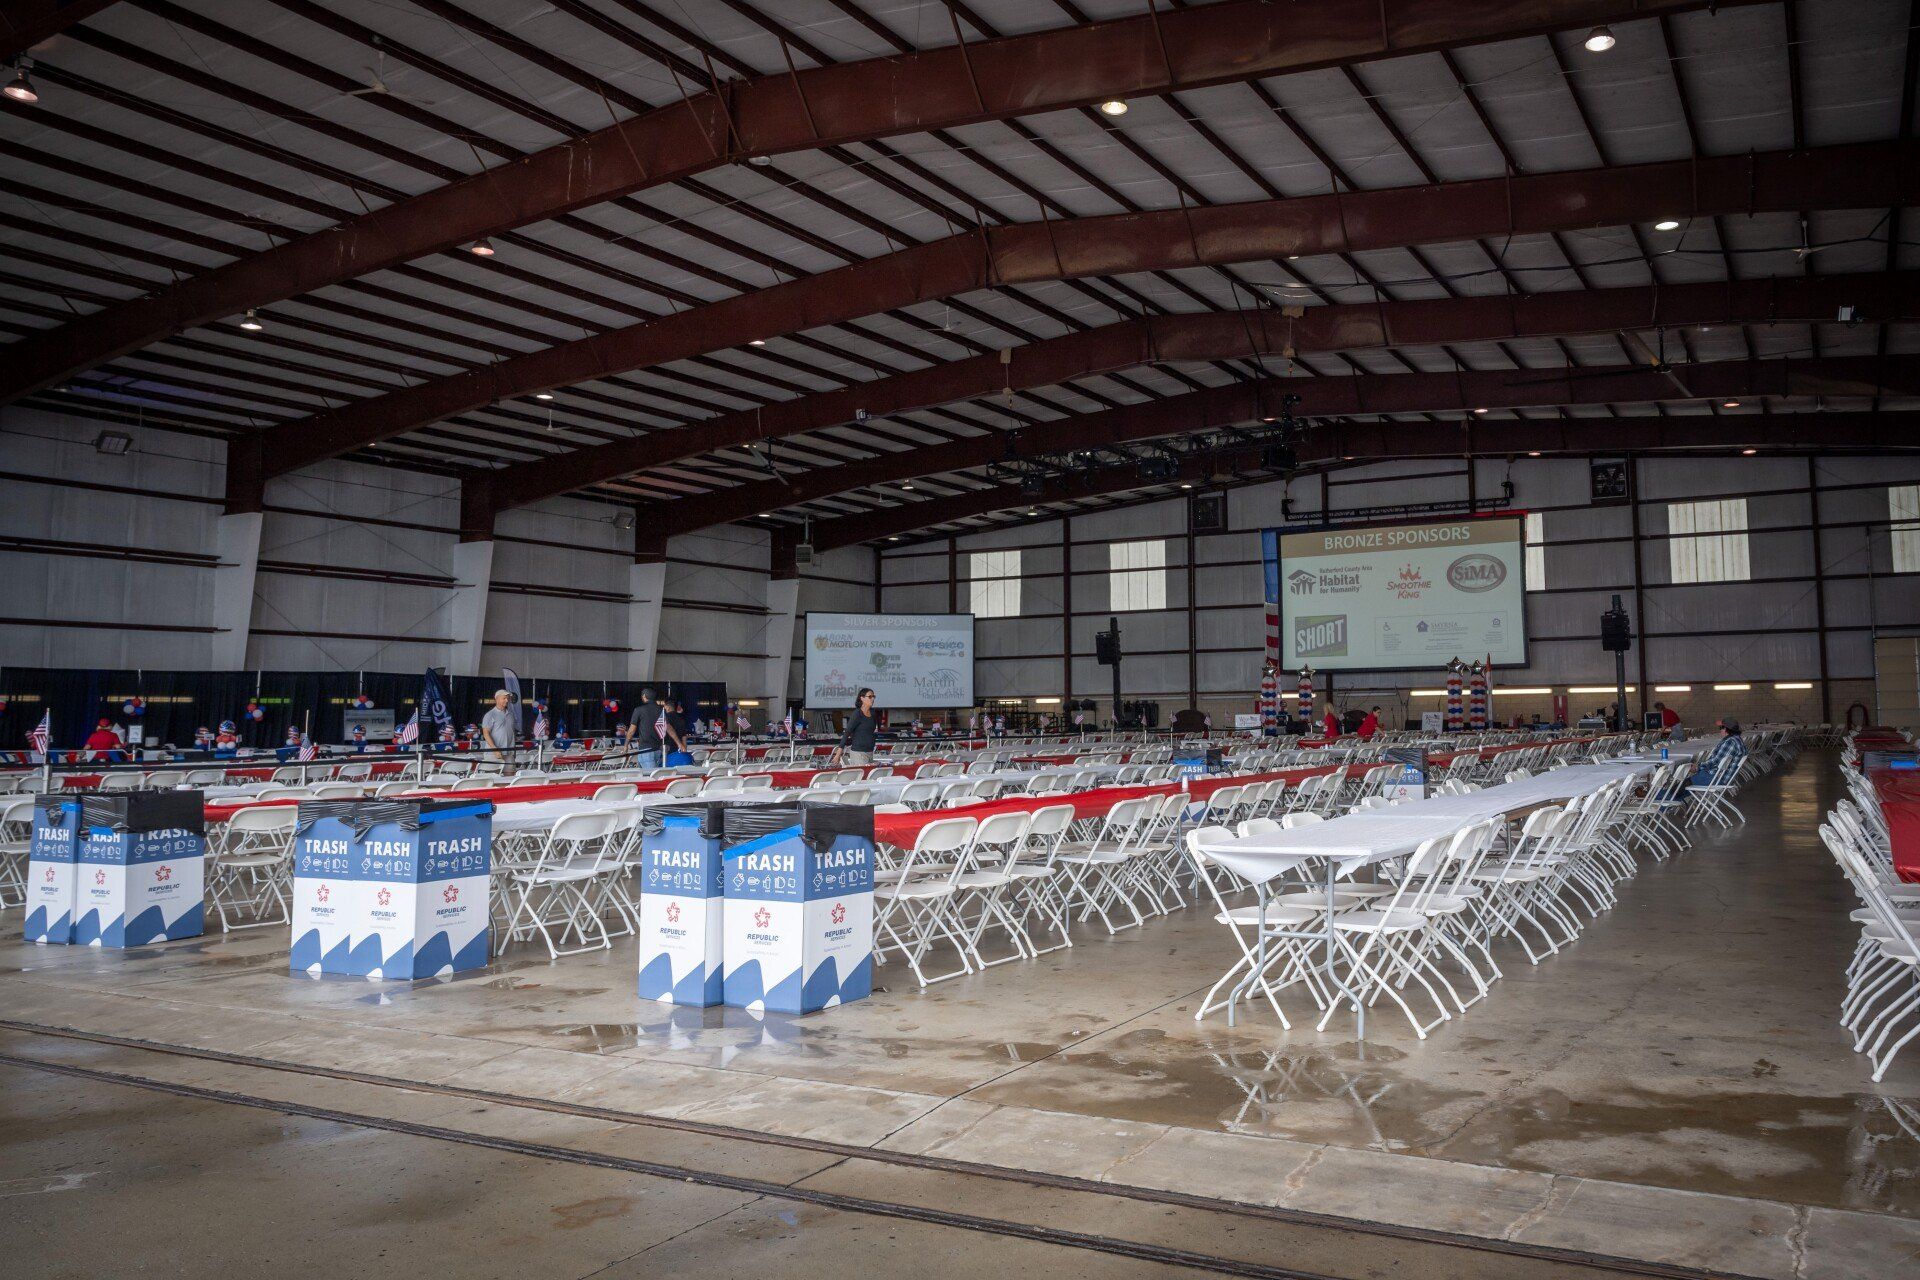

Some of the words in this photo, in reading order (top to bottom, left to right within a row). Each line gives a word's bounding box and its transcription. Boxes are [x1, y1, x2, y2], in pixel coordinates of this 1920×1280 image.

[1324, 533, 1383, 550] BRONZE
[1388, 526, 1470, 545] SPONSORS
[1319, 574, 1360, 586] Habitat
[1386, 580, 1432, 591] SMOOTHIE
[1330, 585, 1361, 595] Humanity
[843, 617, 878, 627] SILVER
[881, 616, 938, 627] SPONSORS
[1297, 619, 1344, 653] SHORT
[870, 640, 893, 648] STATE
[38, 827, 70, 842] TRASH
[88, 833, 121, 843] RASH
[304, 839, 348, 855] TRASH
[365, 841, 411, 857] TRASH
[428, 837, 482, 856] TRASH
[651, 849, 700, 869] TRASH
[737, 854, 795, 872] TRASH
[814, 848, 865, 869] TRASH
[148, 883, 180, 893] REPUBLIC
[311, 906, 336, 914] REPUBLIC
[370, 910, 397, 918] REPUBLIC
[436, 906, 467, 916] REPUBLIC
[659, 927, 687, 936] REPUBLIC
[824, 927, 853, 939] REPUBLIC
[746, 933, 779, 942] REPUBLIC
